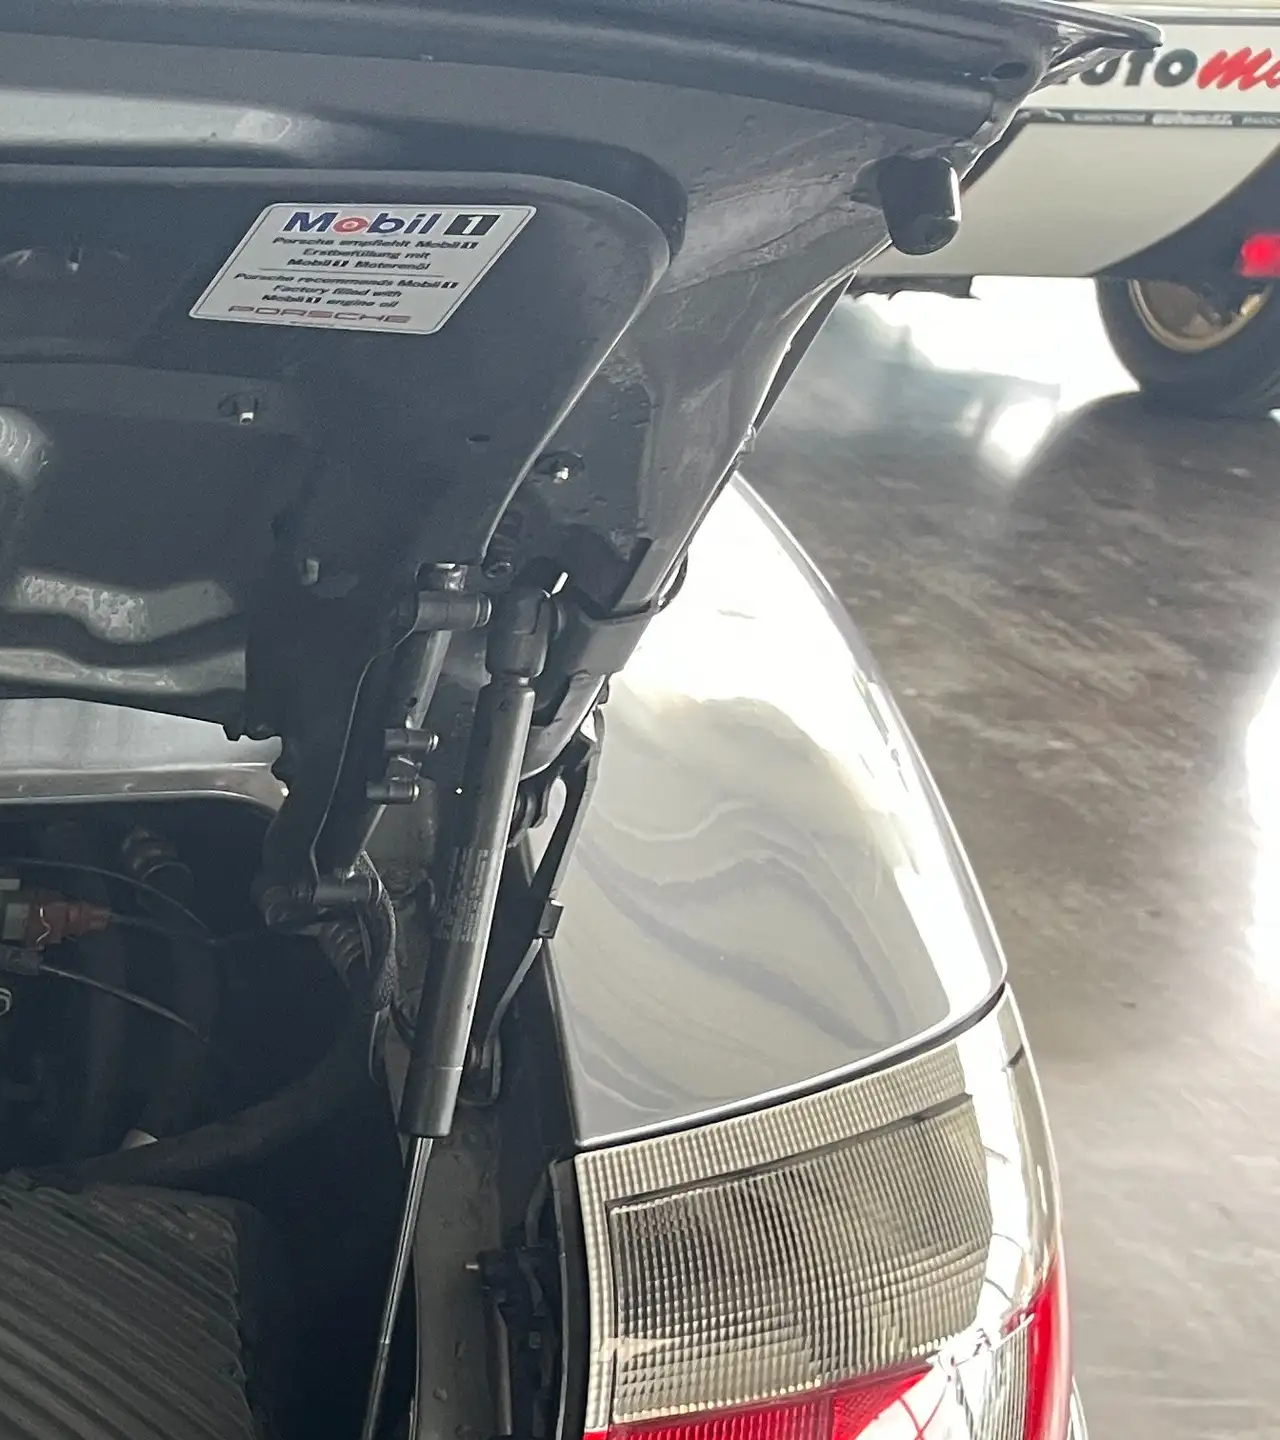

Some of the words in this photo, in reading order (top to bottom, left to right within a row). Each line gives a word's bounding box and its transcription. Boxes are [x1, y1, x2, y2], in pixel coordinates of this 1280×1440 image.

[282, 211, 442, 235] Mobil
[272, 236, 334, 247] Porsche
[339, 238, 411, 249] empfiehlt
[415, 239, 460, 250] Mobil
[302, 247, 401, 260] Erstbefüllung
[404, 251, 430, 260] mit
[287, 257, 331, 267] Mobil
[354, 259, 431, 271] Motorenöl
[233, 272, 295, 283] Porsche
[298, 276, 392, 288] recommends
[396, 278, 441, 289] Mobil
[272, 284, 329, 296] Factory
[332, 287, 369, 297] filled
[372, 288, 402, 298] with
[261, 293, 305, 304] Mobil
[326, 298, 376, 309] engine
[379, 299, 399, 309] oil
[227, 305, 413, 324] PORSCHE
